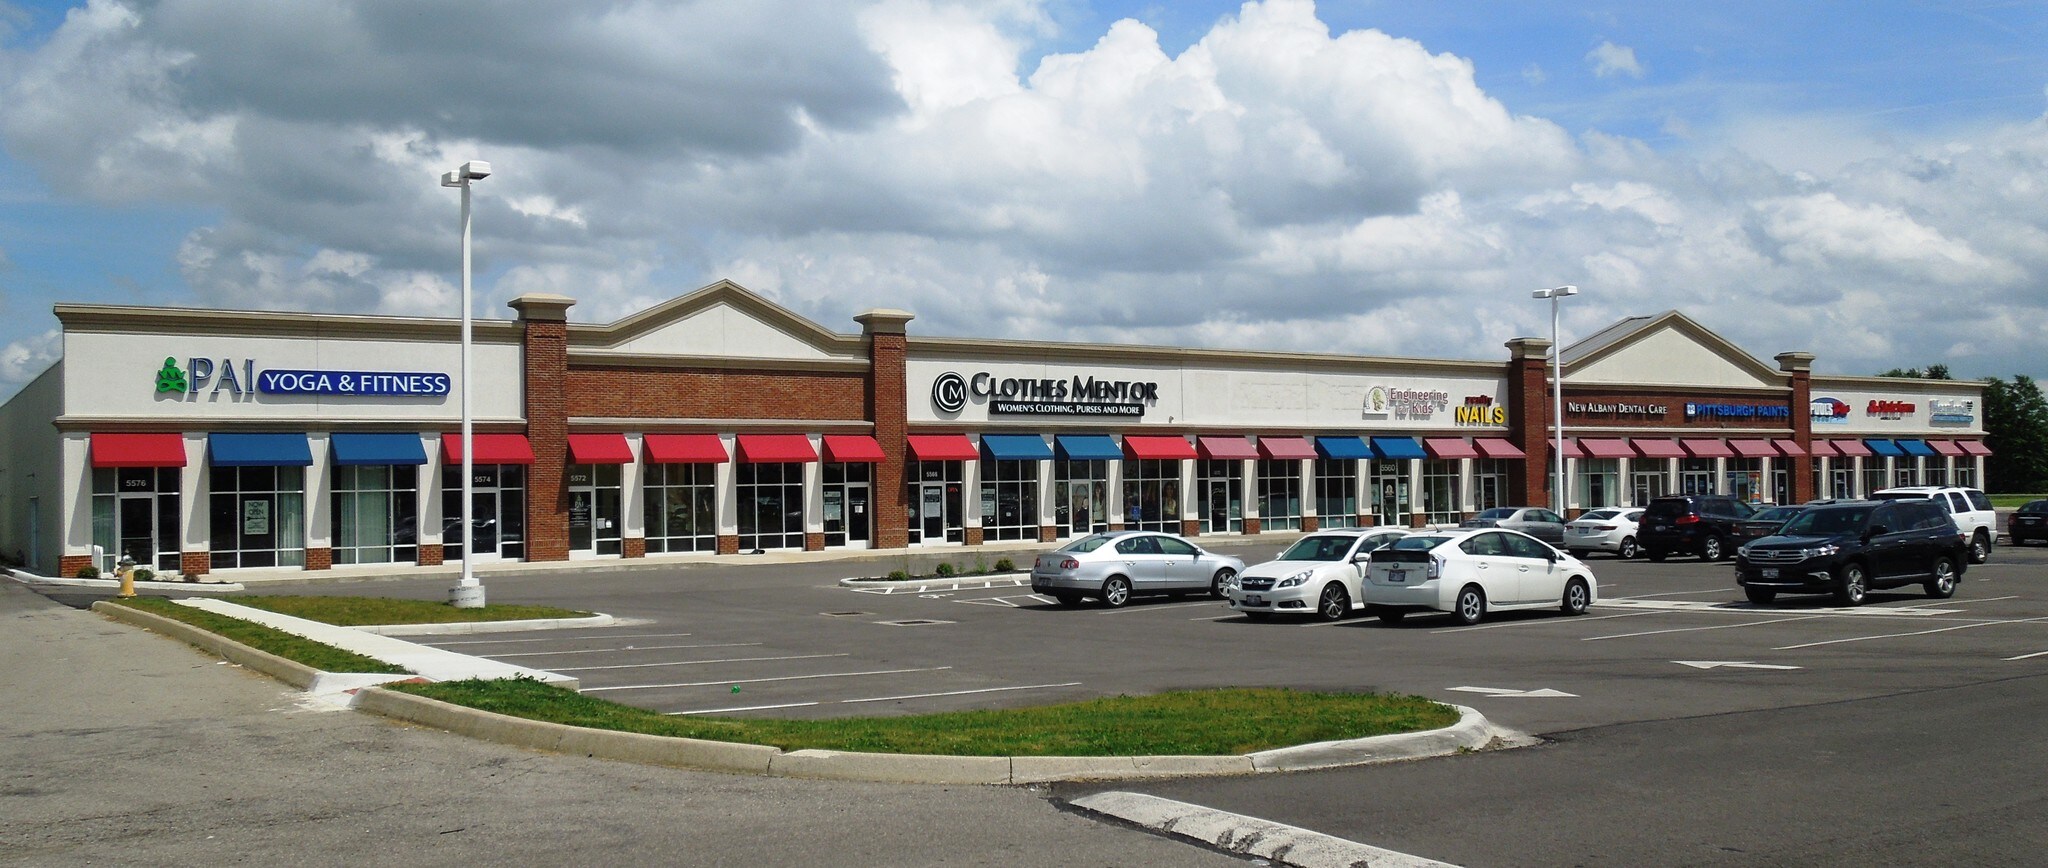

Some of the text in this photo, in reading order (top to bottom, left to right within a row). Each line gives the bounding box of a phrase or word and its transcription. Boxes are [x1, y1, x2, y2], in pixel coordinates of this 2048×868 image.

[188, 357, 256, 394] PAI
[265, 373, 446, 393] YOGA & FITNESS
[970, 372, 1159, 400] CLOTHES MENTOR
[1389, 387, 1449, 405] Engineering
[997, 403, 1034, 412] WOMEN'S
[1035, 403, 1075, 414] CLOTHING,
[1076, 405, 1101, 414] PURSES
[1119, 406, 1139, 414] MORE
[1411, 401, 1434, 414] Kids
[1456, 406, 1505, 424] NAILS
[1568, 402, 1668, 414] NEW ALBANY DENTAL CARE
[1696, 404, 1755, 416] PITTSBURGH
[1757, 406, 1789, 417] PAINTS
[126, 479, 147, 487] 5576
